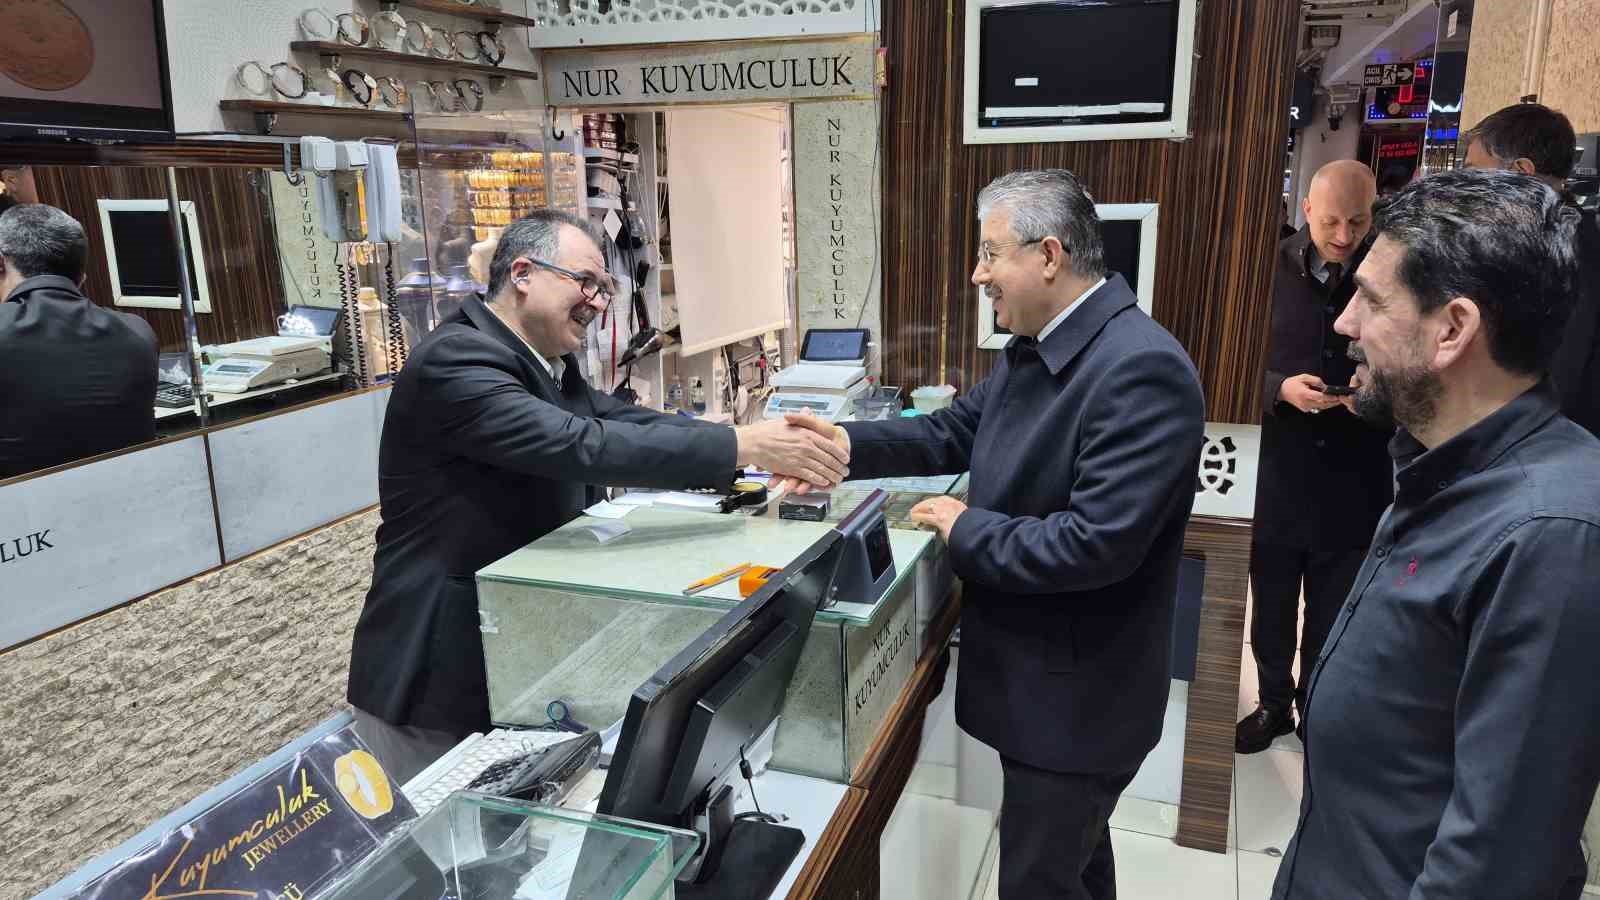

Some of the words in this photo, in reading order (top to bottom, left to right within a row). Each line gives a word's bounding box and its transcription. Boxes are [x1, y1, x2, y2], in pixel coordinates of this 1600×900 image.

[562, 68, 622, 98] NUR
[640, 56, 853, 95] KUYUMCULUK
[827, 118, 841, 163] NUR
[830, 174, 847, 320] KUYUMCULUK
[872, 618, 891, 657] NUR
[855, 623, 910, 716] KUYUMCULUK
[241, 798, 333, 871] JEWELLERY
